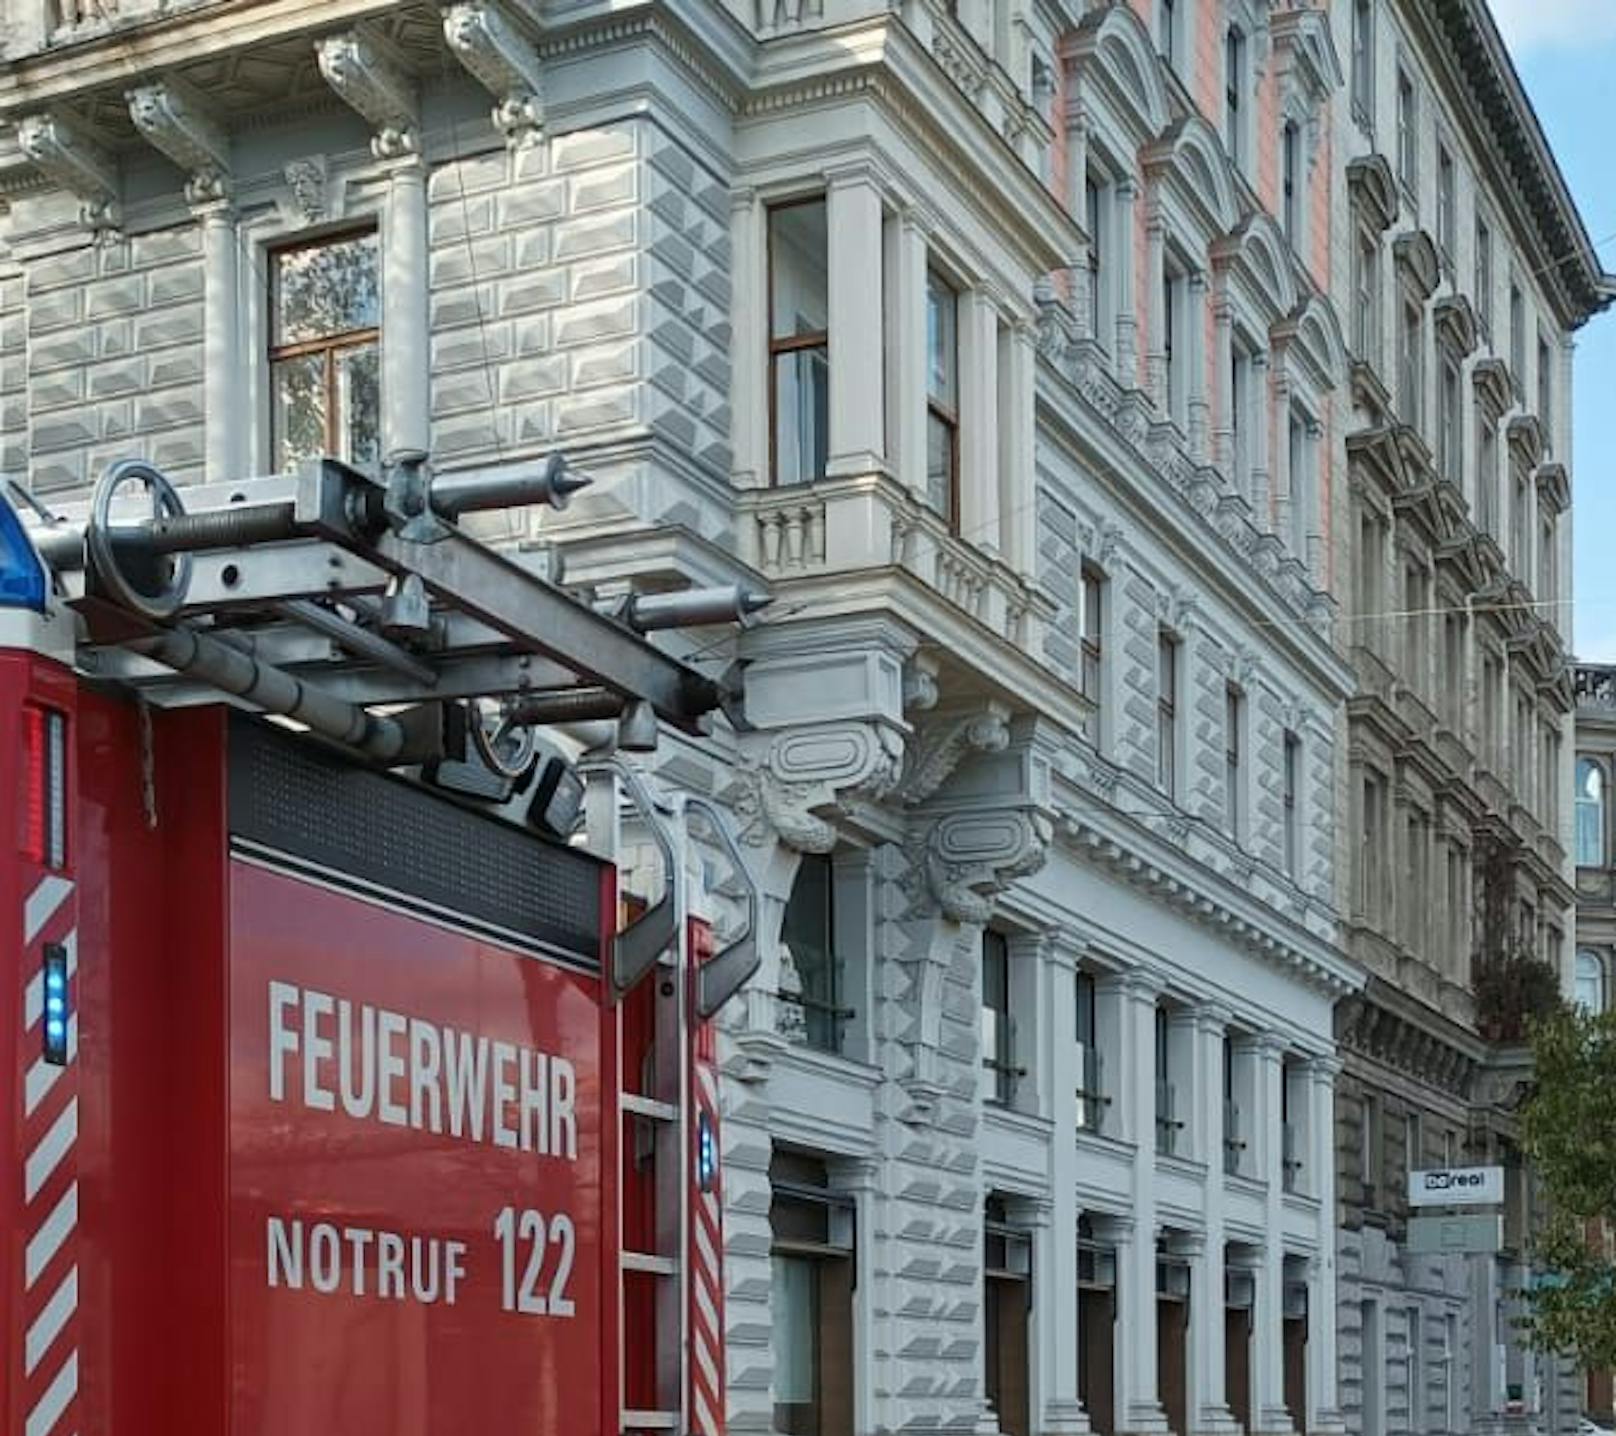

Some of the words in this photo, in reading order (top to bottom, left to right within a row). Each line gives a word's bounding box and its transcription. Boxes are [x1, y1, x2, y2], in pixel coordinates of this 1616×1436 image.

[268, 980, 578, 1161] FEUERWEHR
[267, 1216, 467, 1305] NOTRUF
[494, 1206, 576, 1318] 122
